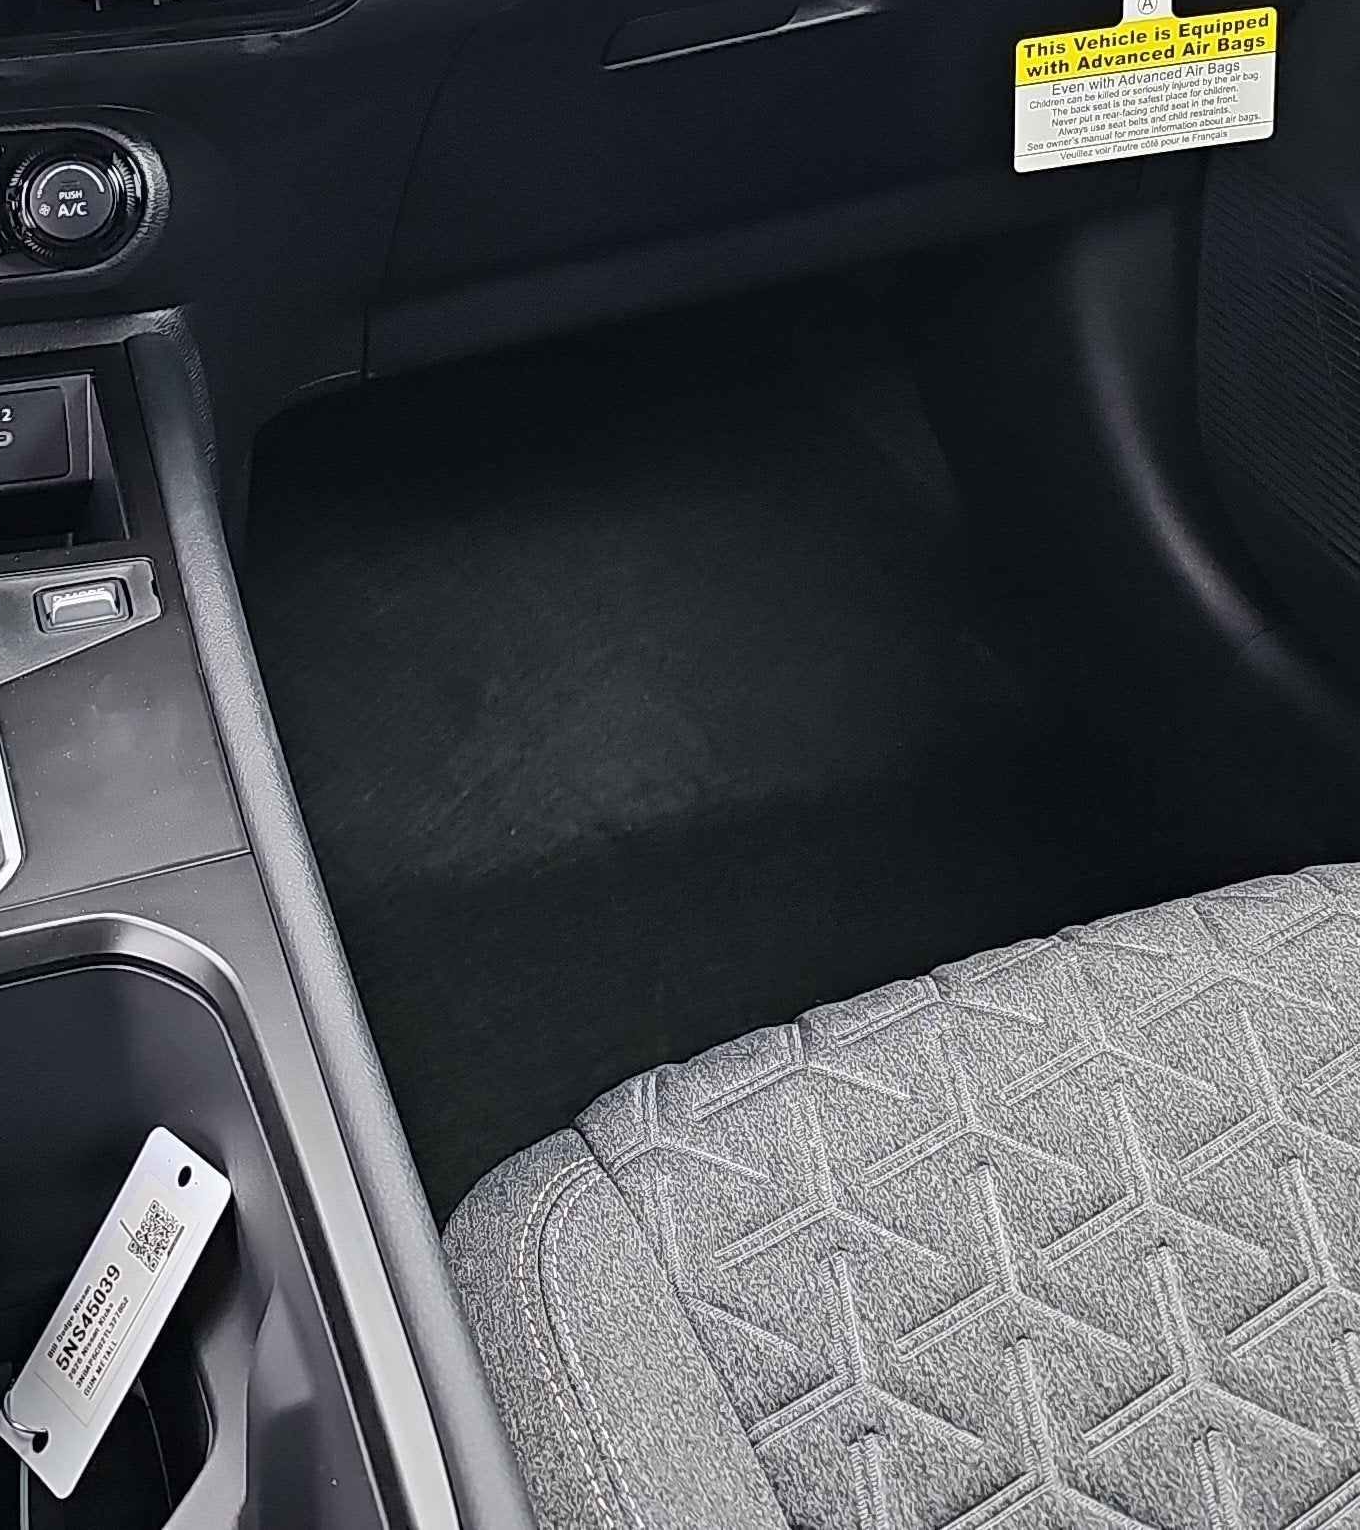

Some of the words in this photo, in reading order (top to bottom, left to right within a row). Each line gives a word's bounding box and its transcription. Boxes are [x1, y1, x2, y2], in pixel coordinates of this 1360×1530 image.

[1023, 40, 1066, 59] This
[1074, 29, 1148, 52] Vehicle
[1154, 26, 1171, 41] is
[1179, 13, 1269, 39] Equipped
[1026, 59, 1070, 78] with
[1076, 44, 1175, 71] Advanced
[1181, 41, 1211, 57] Air
[1217, 36, 1266, 52] Bags
[1029, 97, 1065, 110] Children
[1066, 95, 1083, 105] can
[1084, 93, 1095, 102] be
[1097, 89, 1120, 100] killed
[1121, 88, 1131, 97] or
[1172, 78, 1200, 92] injured
[1202, 77, 1213, 88] by
[1214, 75, 1228, 84] the
[1230, 73, 1241, 83] air
[1052, 82, 1085, 96] Even
[1089, 76, 1115, 91] with
[1118, 67, 1182, 87] Advanced
[1185, 64, 1204, 78] Air
[1207, 62, 1240, 75] Bags
[1051, 108, 1068, 117] The
[1070, 104, 1091, 114] back
[1092, 101, 1111, 110] seat
[1112, 99, 1120, 109] is
[1122, 97, 1136, 107] the
[1165, 91, 1188, 102] place
[1190, 89, 1201, 98] for
[1051, 117, 1077, 127] Never
[1079, 114, 1093, 125] put
[1102, 107, 1148, 120] rear-facing
[1149, 103, 1169, 113] child
[1171, 101, 1190, 110] seat
[1191, 99, 1199, 108] in
[1201, 97, 1215, 107] the
[1027, 142, 1044, 151] See
[1046, 137, 1080, 149] owner's
[1081, 132, 1113, 144] manual
[1114, 130, 1125, 139] for
[1127, 127, 1150, 137] more
[1151, 120, 1198, 134] information
[1199, 116, 1224, 127] about
[1225, 114, 1237, 124] air
[1058, 126, 1089, 137] Always
[1090, 123, 1106, 132] use
[1108, 119, 1127, 129] seat
[1128, 116, 1149, 127] belts
[1150, 113, 1166, 123] and
[1168, 111, 1188, 121] child
[1095, 146, 1112, 155] voir
[1160, 137, 1180, 148] pour
[1181, 134, 1190, 143] le
[1192, 130, 1228, 142] Français
[57, 201, 88, 218] A/C
[58, 189, 83, 201] PUSH
[1, 408, 12, 422] 2
[55, 1264, 121, 1371] 5NS45039
[56, 1315, 75, 1340] Dodge
[72, 1285, 92, 1314] Nissan
[81, 1328, 100, 1357] Nissan
[98, 1302, 114, 1327] Kicks
